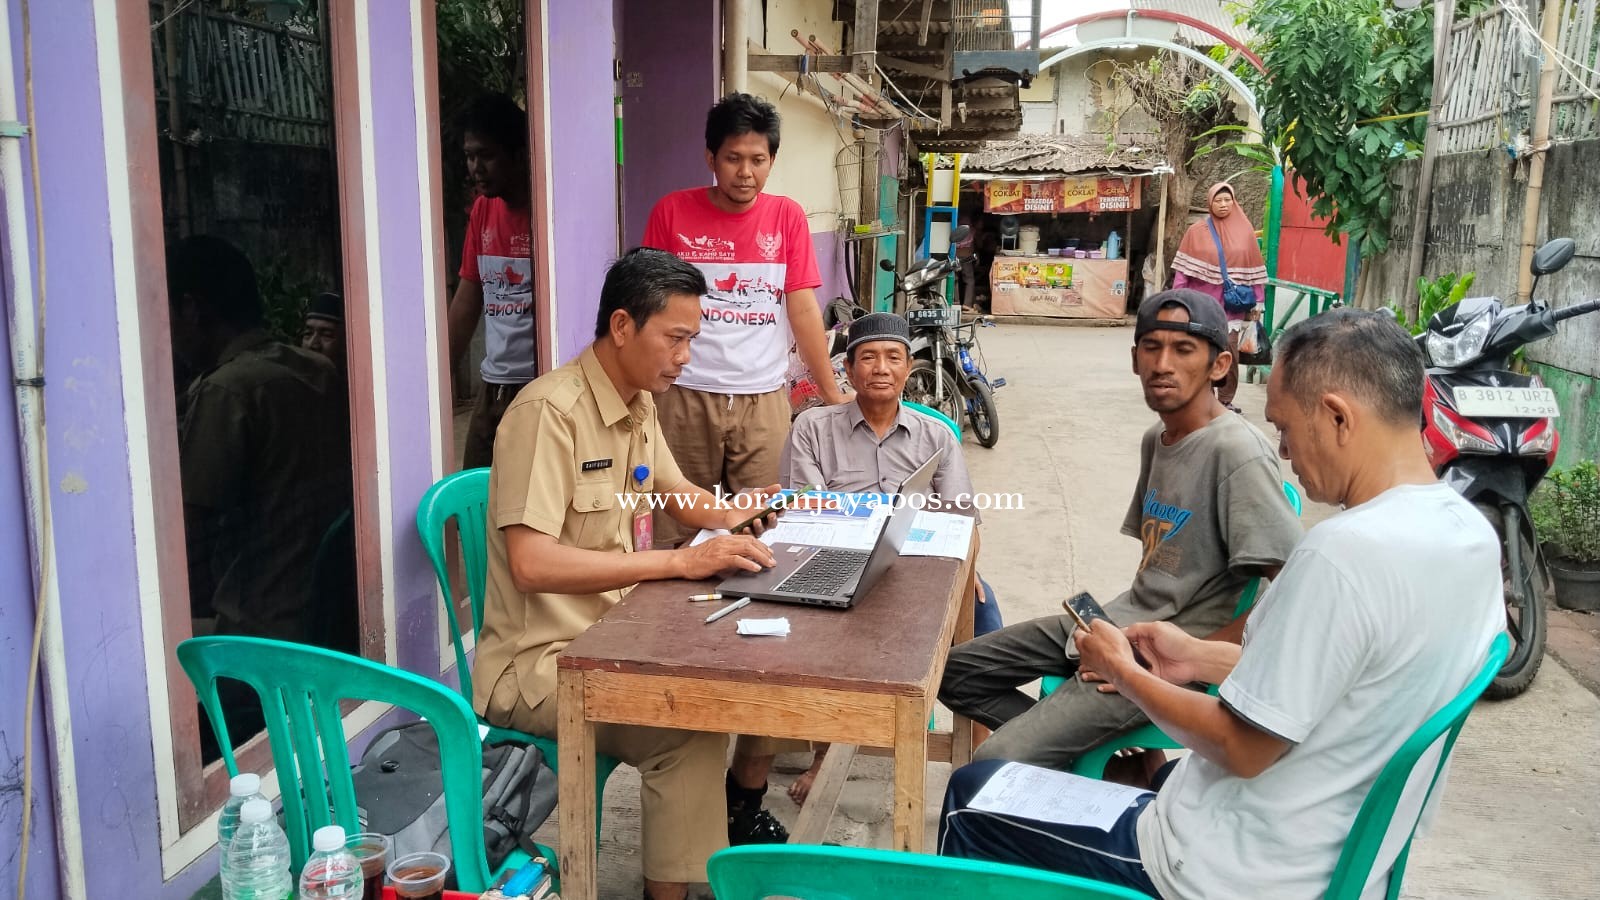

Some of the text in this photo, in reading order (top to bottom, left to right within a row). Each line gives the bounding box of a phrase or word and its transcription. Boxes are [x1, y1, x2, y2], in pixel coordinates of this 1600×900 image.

[1067, 189, 1095, 197] COKLAT
[699, 307, 777, 326] NDONESIA
[1457, 389, 1552, 402] B 3812 URZ
